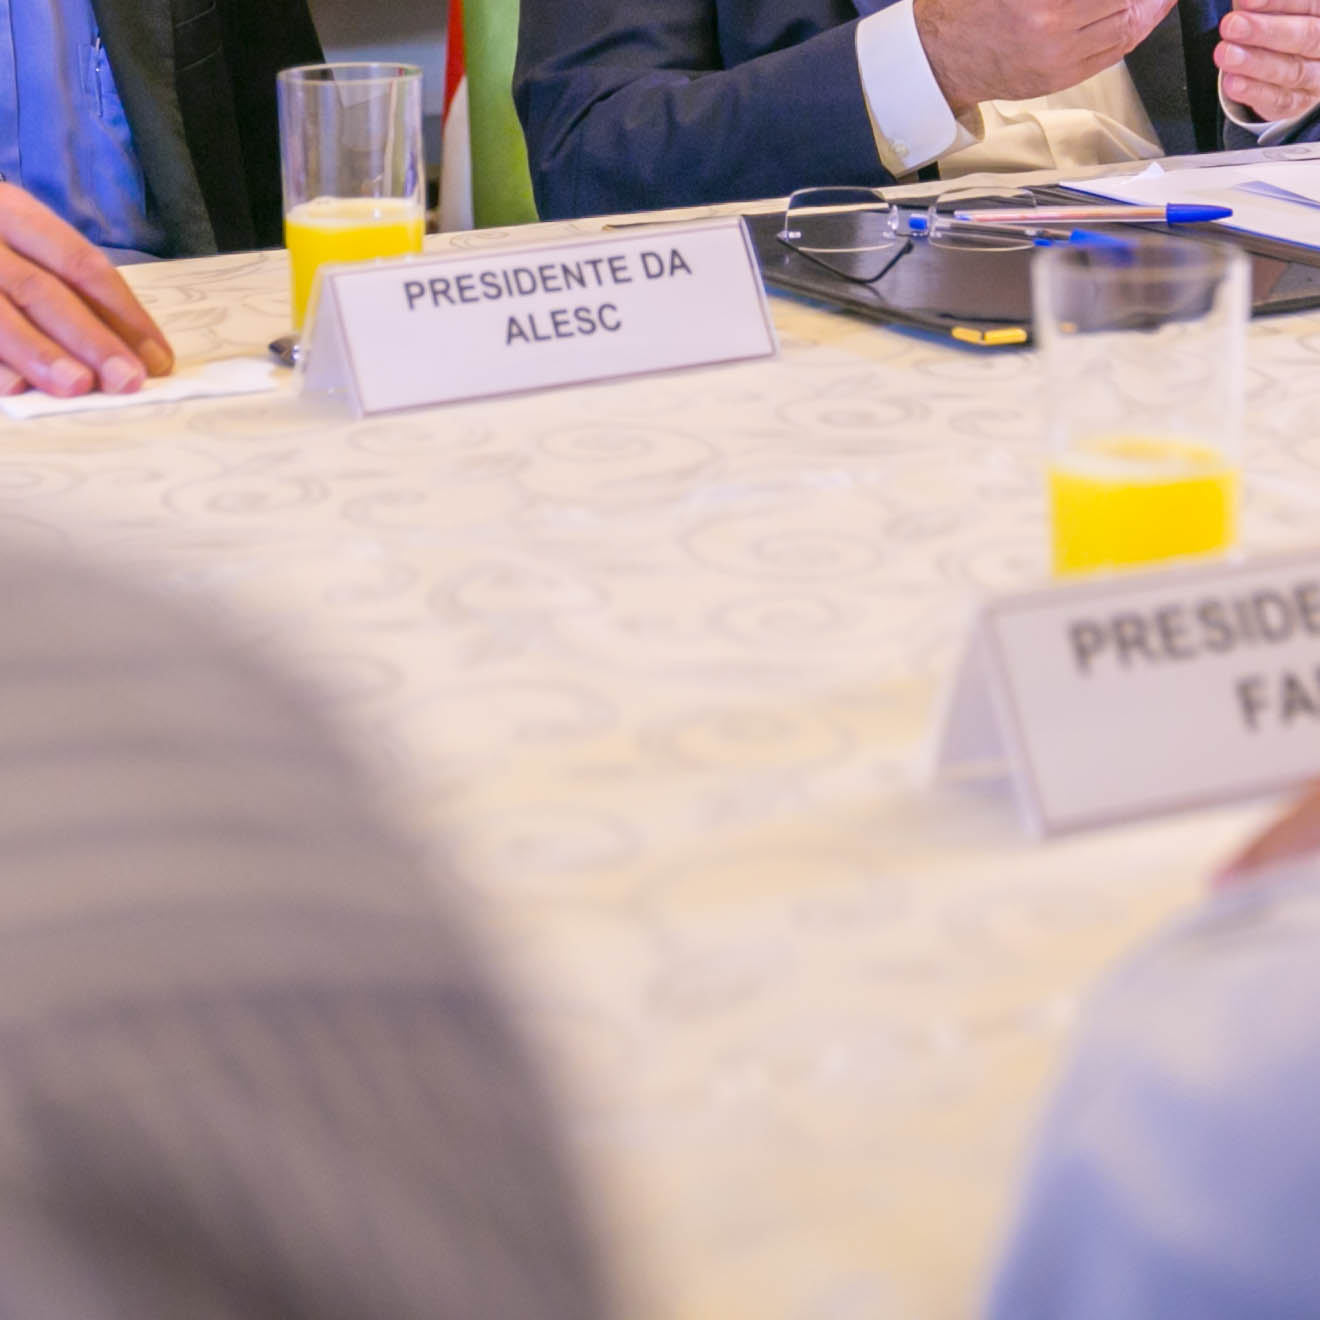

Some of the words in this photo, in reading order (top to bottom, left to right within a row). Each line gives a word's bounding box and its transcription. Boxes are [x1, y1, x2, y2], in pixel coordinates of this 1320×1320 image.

[404, 254, 632, 310] PRESIDENTE
[641, 248, 692, 278] DA
[505, 303, 622, 345] ALESC
